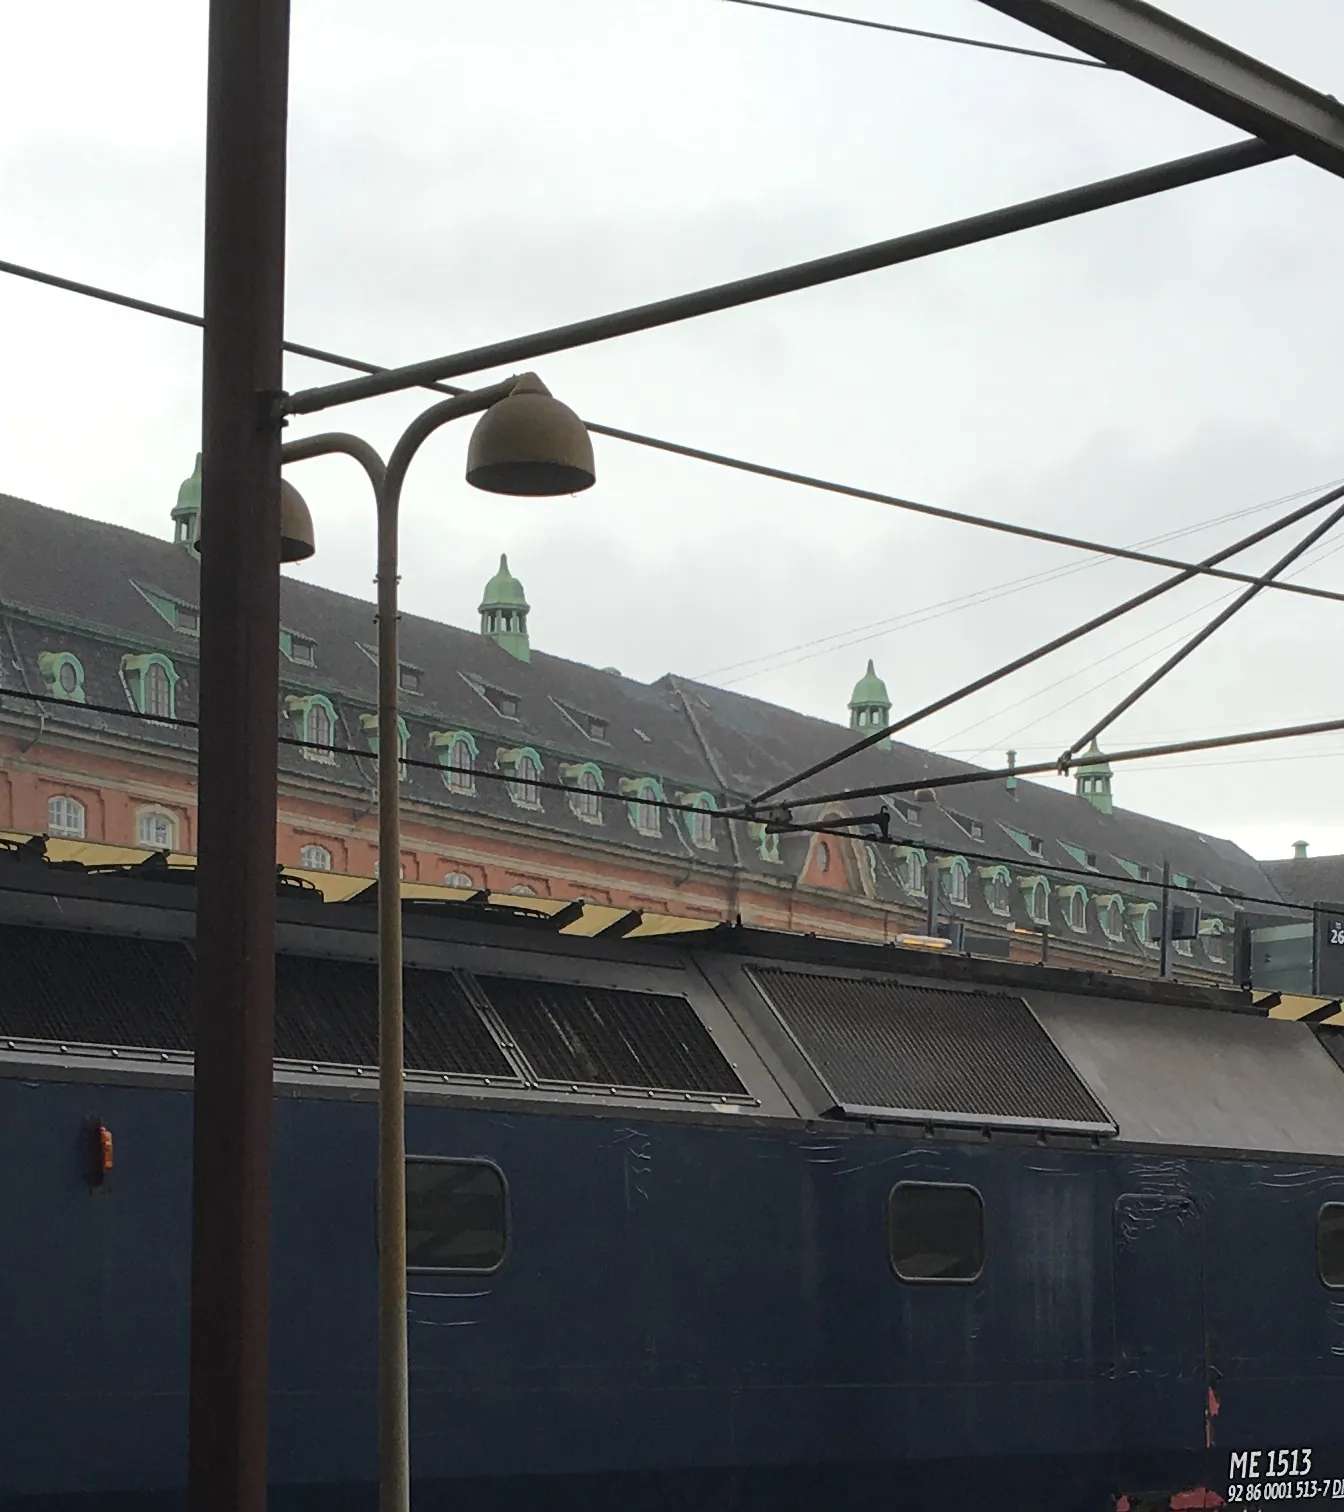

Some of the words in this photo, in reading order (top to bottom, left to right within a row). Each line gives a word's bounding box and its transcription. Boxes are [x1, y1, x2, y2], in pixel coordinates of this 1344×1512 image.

[1229, 1450, 1262, 1479] ME
[1265, 1448, 1312, 1477] 1513
[1227, 1484, 1244, 1503] 92
[1245, 1483, 1262, 1502] 86
[1263, 1481, 1293, 1500] 0001
[1295, 1479, 1331, 1498] 513-7
